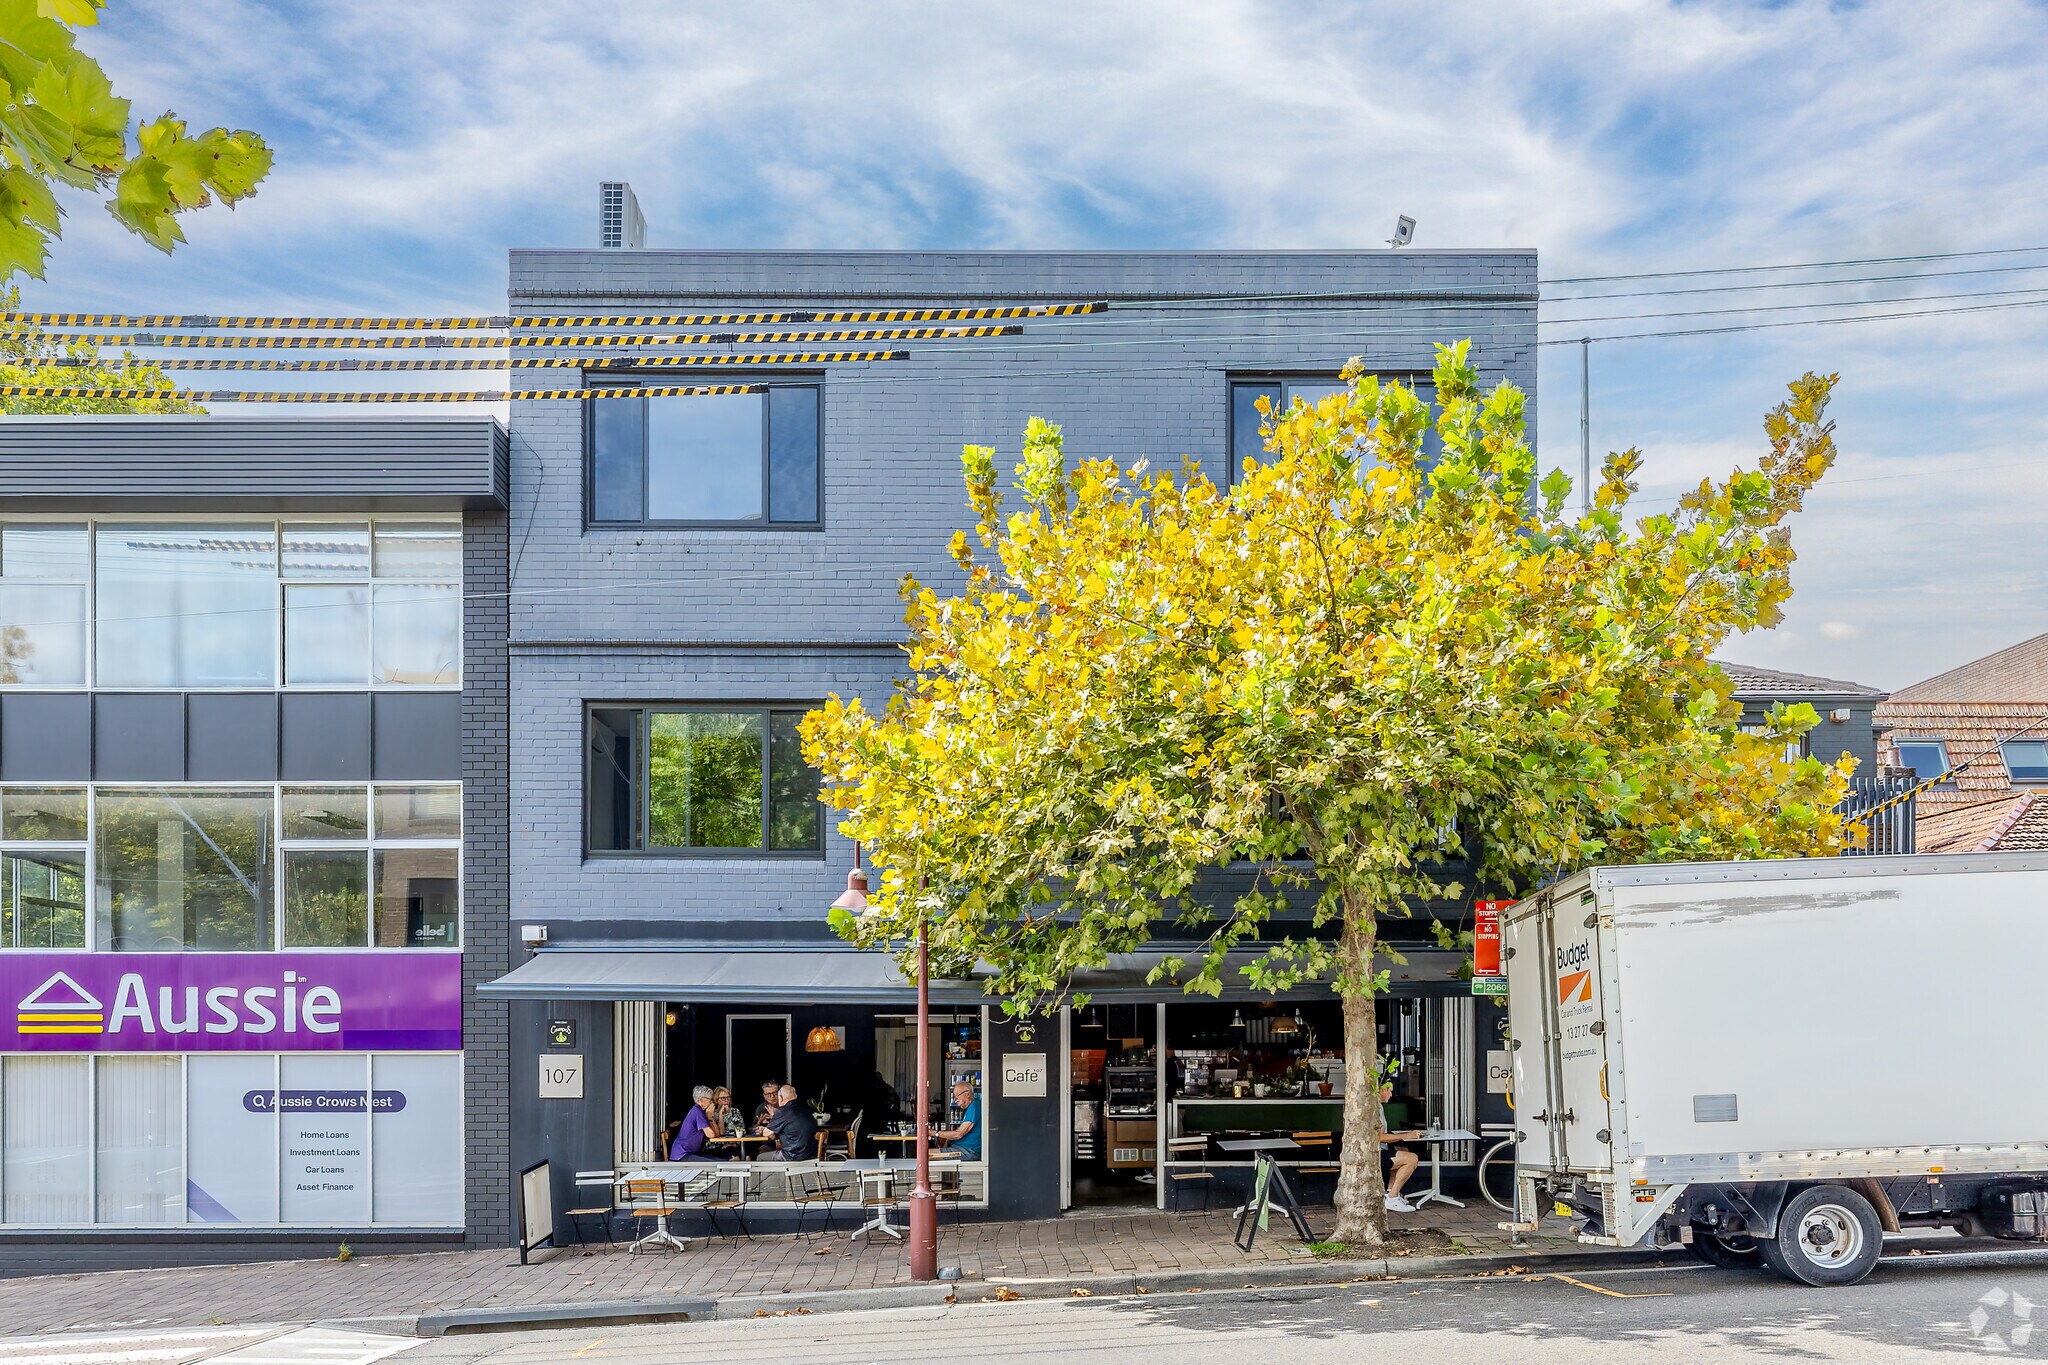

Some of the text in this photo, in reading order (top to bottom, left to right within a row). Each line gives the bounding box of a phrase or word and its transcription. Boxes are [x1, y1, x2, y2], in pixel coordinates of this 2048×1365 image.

[1486, 902, 1496, 910] NO
[1557, 938, 1590, 971] Budget
[108, 970, 342, 1034] Aussie
[1574, 1025, 1581, 1039] 27
[1582, 1023, 1588, 1037] 27
[545, 1068, 577, 1084] 107
[1005, 1068, 1039, 1083] Cafe
[316, 1096, 358, 1107] Crows
[360, 1096, 393, 1107] Nest
[300, 1131, 350, 1139] Home Loans
[289, 1148, 361, 1156] Investment Loans
[305, 1166, 345, 1174] Car Loans
[296, 1183, 354, 1191] Asset Finance
